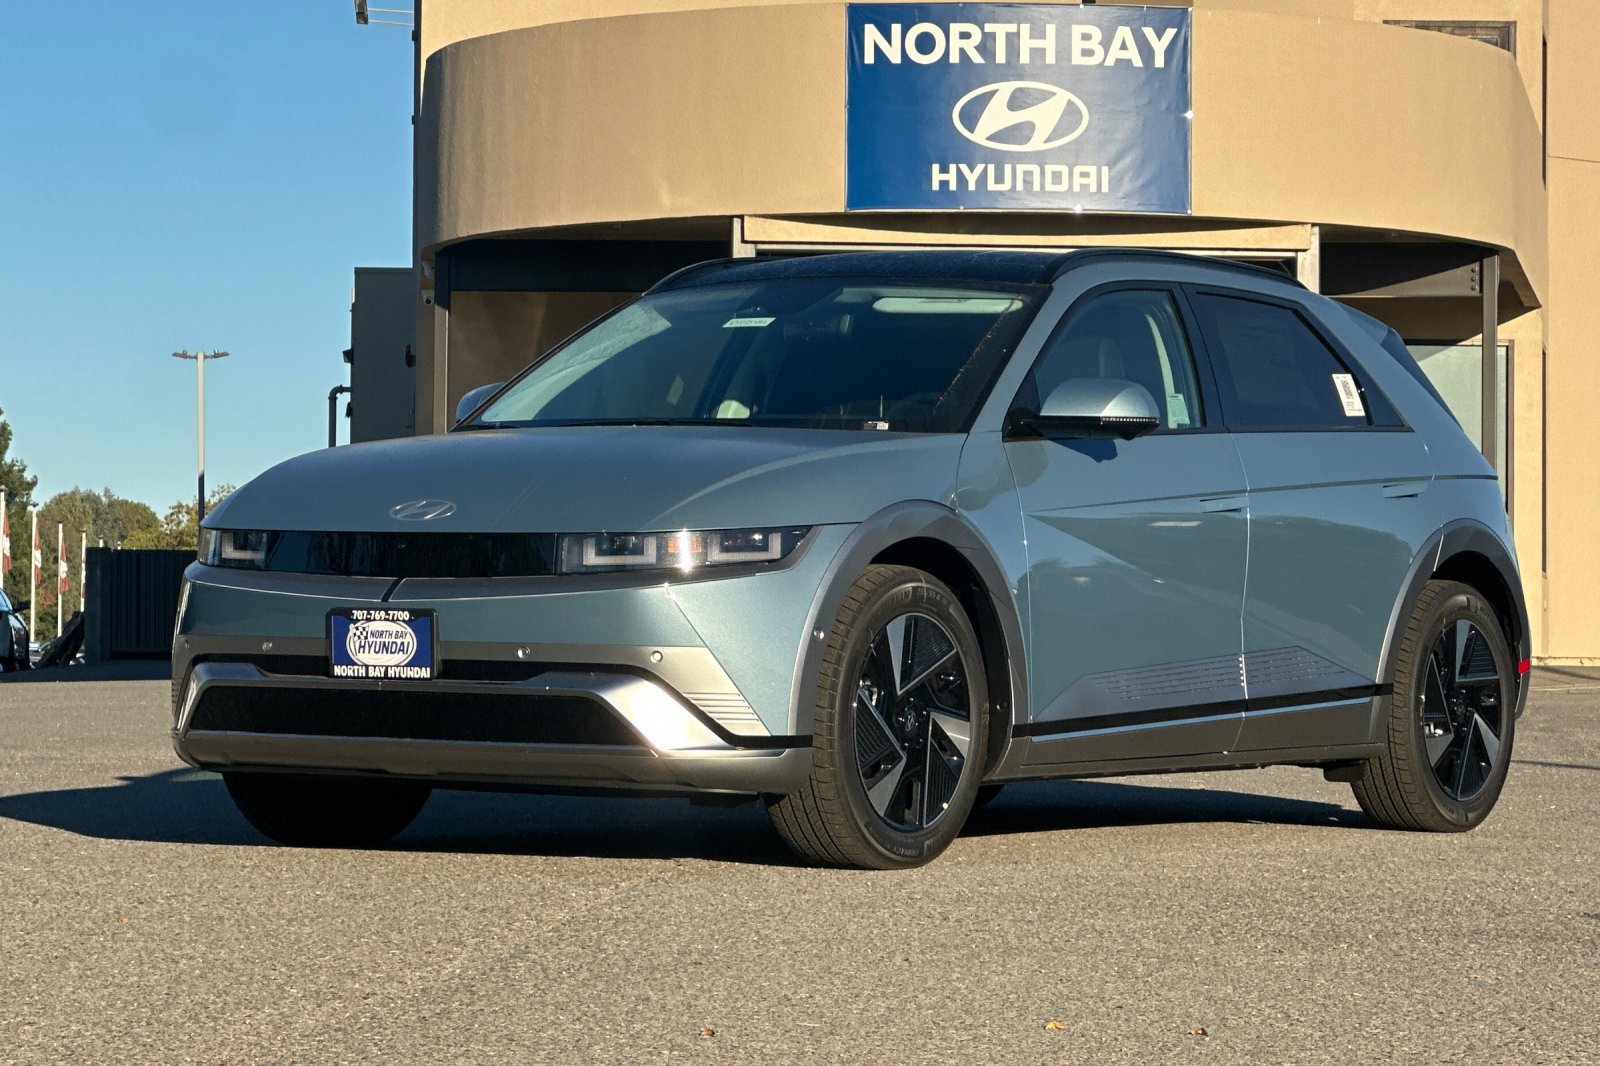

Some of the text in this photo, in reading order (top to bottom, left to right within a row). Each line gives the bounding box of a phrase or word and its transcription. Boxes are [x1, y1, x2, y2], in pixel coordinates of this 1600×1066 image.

[864, 22, 1178, 68] NORTH BAY
[931, 163, 1109, 193] HYUNDAI
[352, 610, 410, 620] 707-769-7700
[369, 630, 408, 639] NORTH BAY
[357, 641, 410, 655] HYUNDAI
[333, 665, 431, 678] NORTH BAY HYUNDAI
